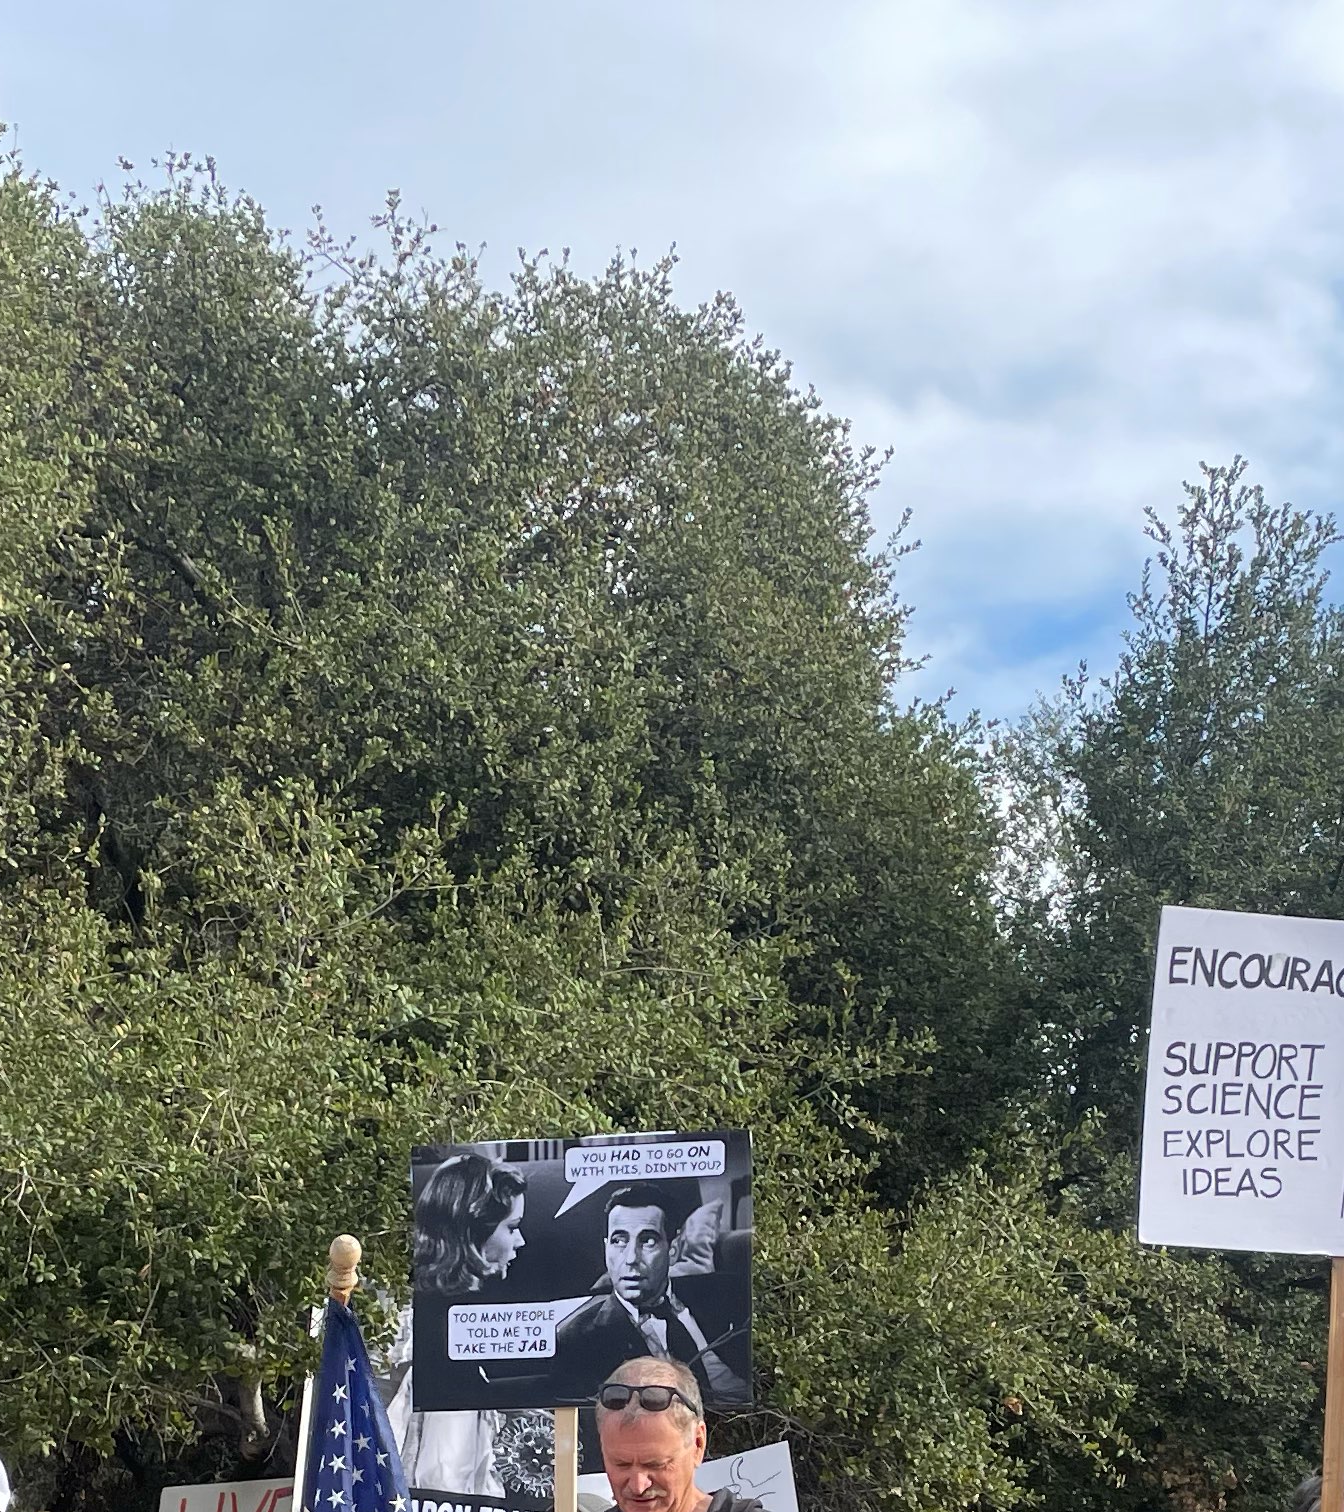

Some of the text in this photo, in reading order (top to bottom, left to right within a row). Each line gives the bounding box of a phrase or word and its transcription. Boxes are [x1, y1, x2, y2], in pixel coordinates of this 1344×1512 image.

[1163, 1041, 1325, 1082] SUPPORT
[1162, 1083, 1323, 1120] SCIENCE
[1163, 1129, 1321, 1161] EXPLORE
[582, 1146, 710, 1163] YOU HAD TO GO ON
[571, 1166, 603, 1177] WITH
[645, 1162, 688, 1174] DIDN'T
[690, 1160, 722, 1171] YOU?
[1182, 1167, 1282, 1199] IDEAS
[453, 1310, 555, 1323] TOO MANY PEOPLE
[467, 1326, 542, 1338] TOLD ME TO
[455, 1343, 486, 1354] TAKE
[490, 1342, 514, 1353] THE
